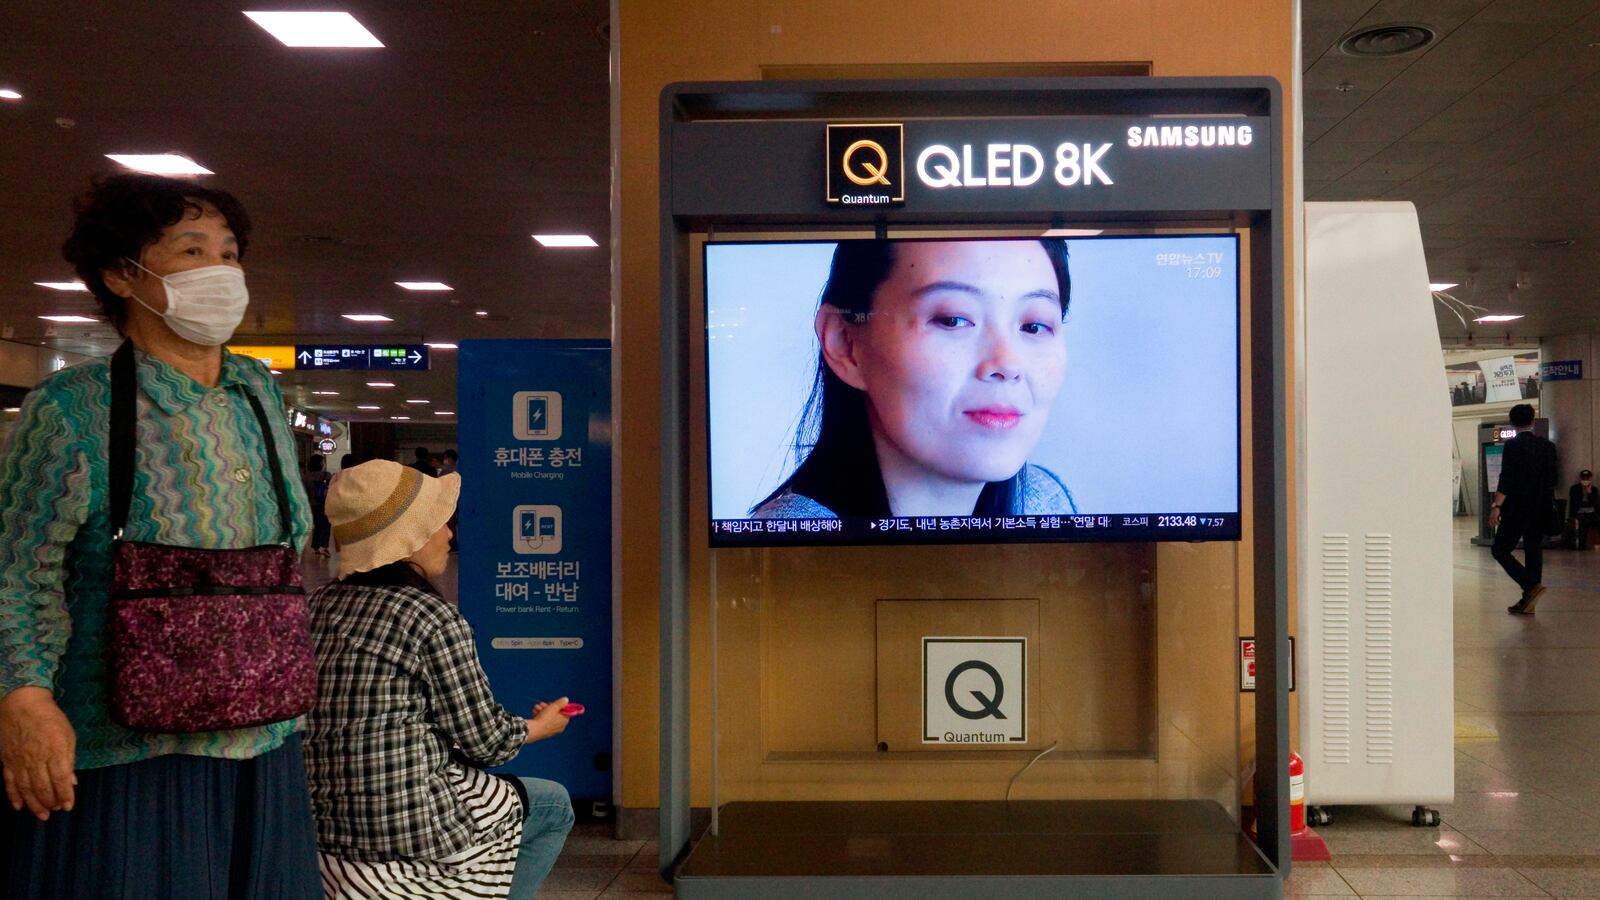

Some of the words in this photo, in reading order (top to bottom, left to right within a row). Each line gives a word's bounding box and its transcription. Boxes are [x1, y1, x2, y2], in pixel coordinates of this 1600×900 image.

[1127, 125, 1253, 147] SAMSUNG
[916, 144, 1045, 188] QLED
[1054, 142, 1114, 187] 8K
[841, 194, 889, 205] Quantum
[1156, 252, 1223, 266] 연합뉴스TV
[1187, 266, 1222, 279] 17:09
[493, 447, 545, 467] 휴대폰
[548, 447, 582, 467] 충전
[511, 471, 533, 479] Mobile
[533, 471, 564, 480] Charging
[721, 520, 764, 533] 책임지고
[766, 520, 797, 533] 한달내
[800, 519, 843, 532] 배상해야
[878, 518, 913, 531] 경기도,
[916, 518, 937, 530] 내년
[940, 517, 992, 530] 농촌지역서
[995, 517, 1037, 529] 기본소득
[1122, 516, 1149, 527] 코스피
[1157, 515, 1197, 527] 2133.48
[1207, 518, 1225, 528] 7.57
[495, 561, 580, 580] 보조배터리
[495, 582, 529, 601] 대여
[544, 582, 580, 602] 반납
[495, 605, 517, 613] Power
[517, 605, 535, 613] bank
[535, 605, 551, 613] Rent
[556, 605, 580, 613] Return
[944, 660, 1008, 720] Q
[943, 731, 1005, 743] Quantum
